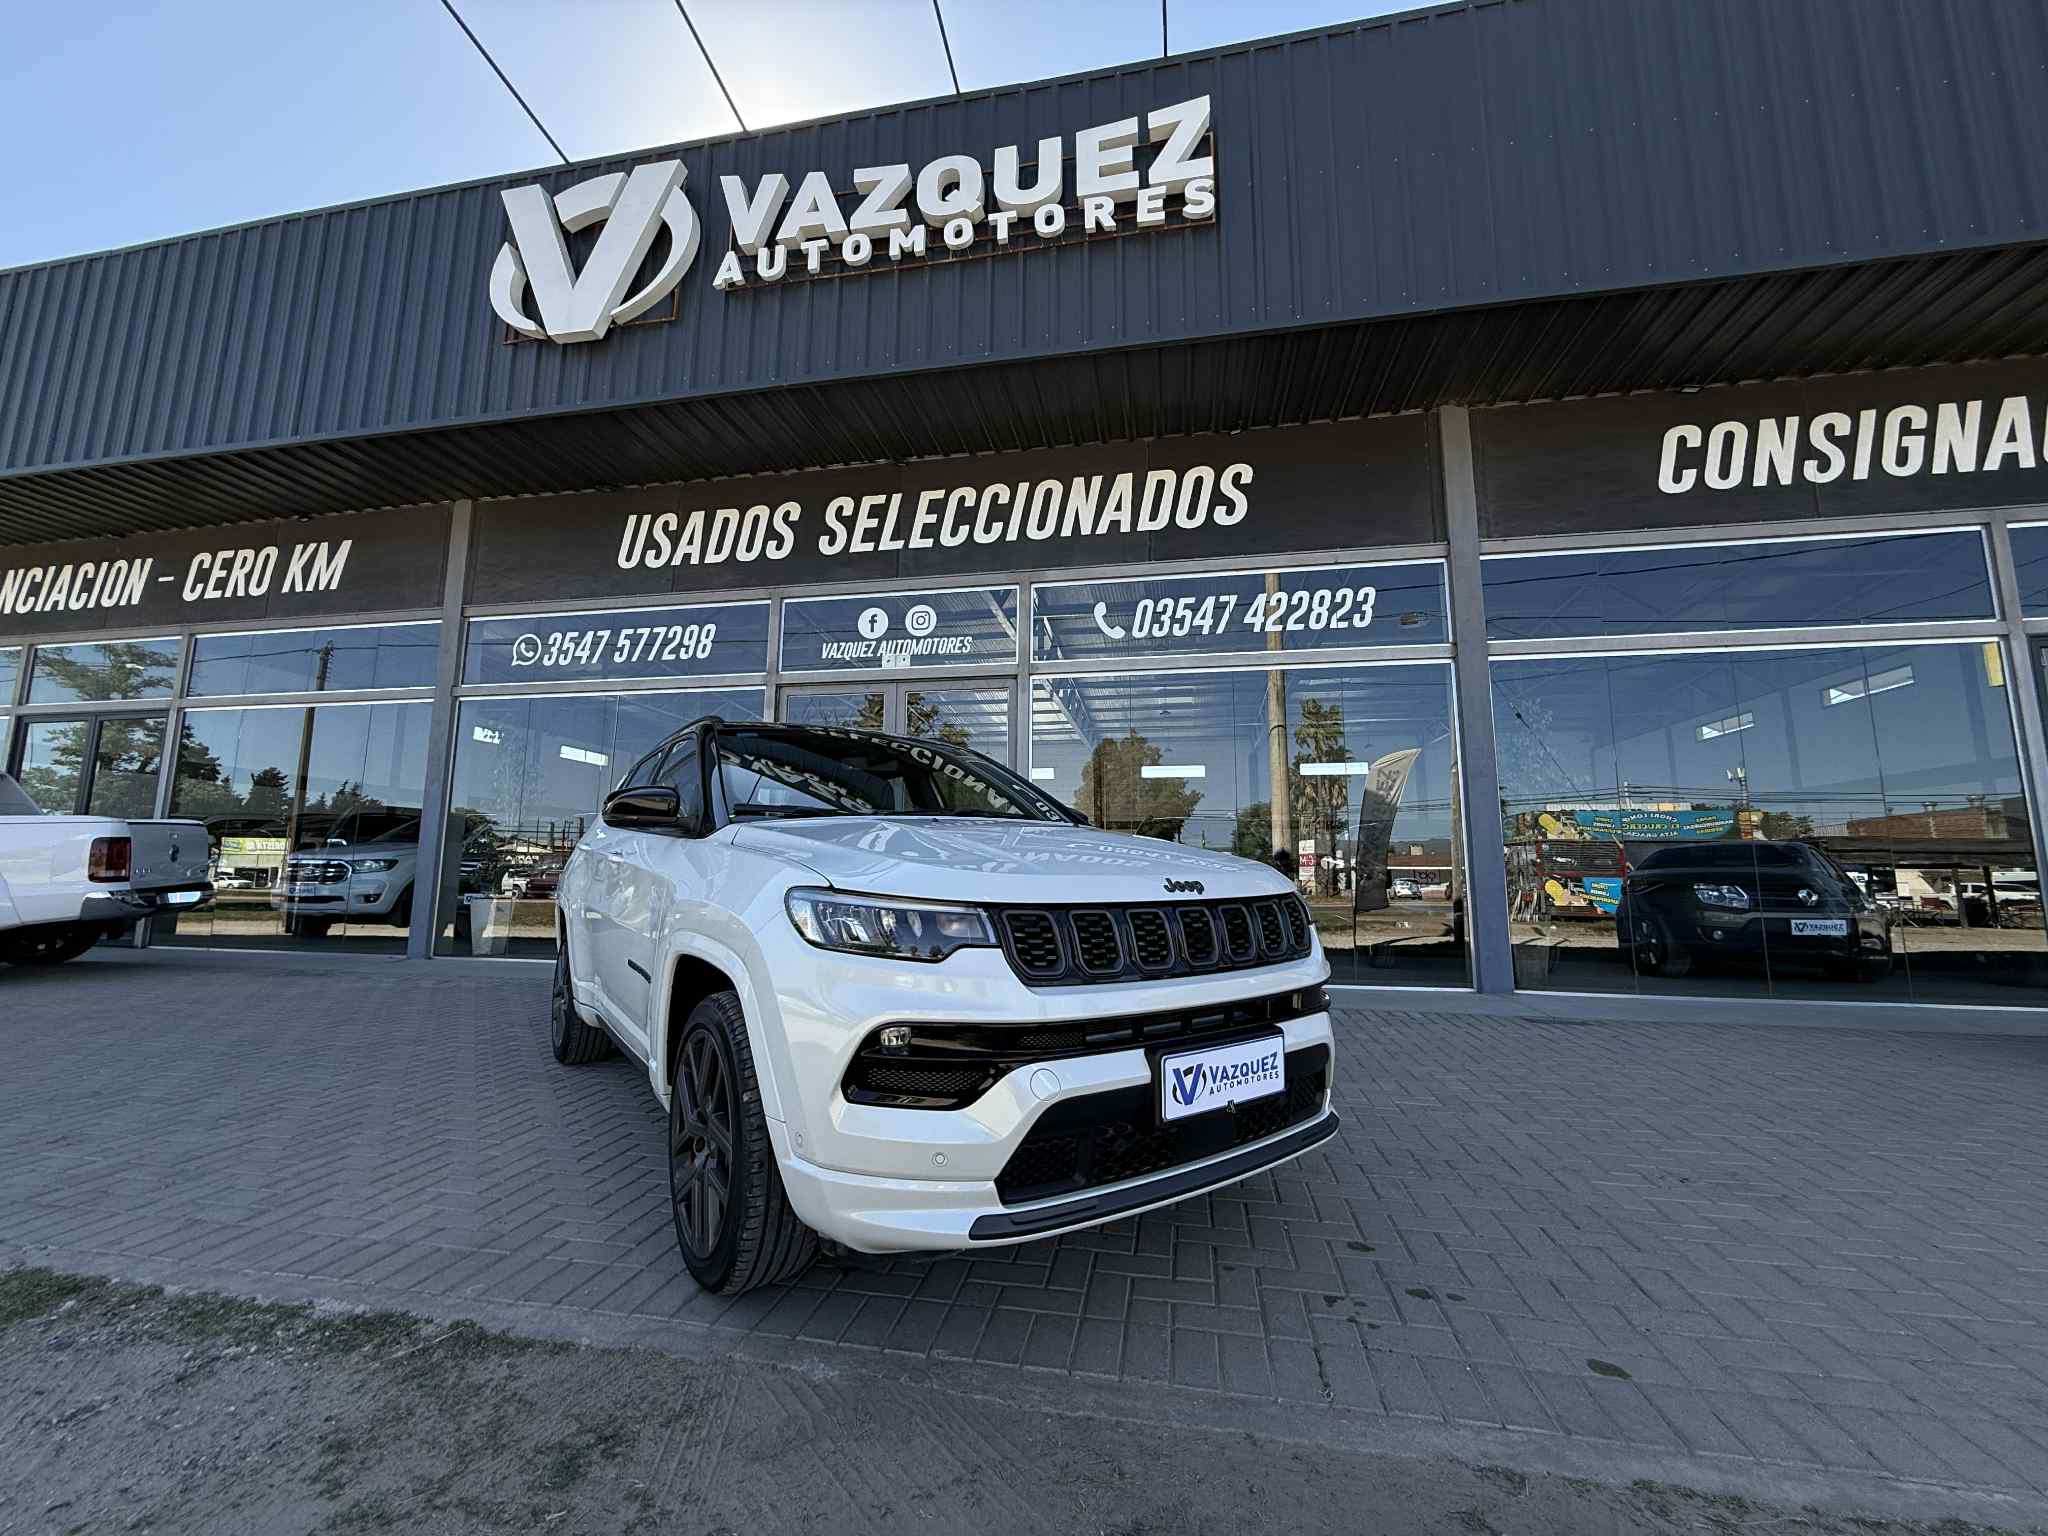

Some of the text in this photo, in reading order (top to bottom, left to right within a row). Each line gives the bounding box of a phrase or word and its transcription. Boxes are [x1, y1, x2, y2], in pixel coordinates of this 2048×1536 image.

[720, 94, 1214, 256] VAZQUEZ
[712, 178, 1216, 291] AUTOMOTORES
[1657, 395, 2048, 494] CONSIGNA
[617, 463, 1254, 569] USADOS SELECCIONADOS
[182, 545, 279, 602] CERO
[281, 539, 353, 593] KM
[1131, 586, 1376, 639] 03547 422823
[542, 623, 717, 667] 3547 577298
[821, 636, 973, 660] VAZQUEZ AUTOMOTORES
[1163, 877, 1205, 895] Jeep
[1209, 1051, 1279, 1085] VAZQUEZ
[1209, 1069, 1280, 1097] AUTOMOTORES
